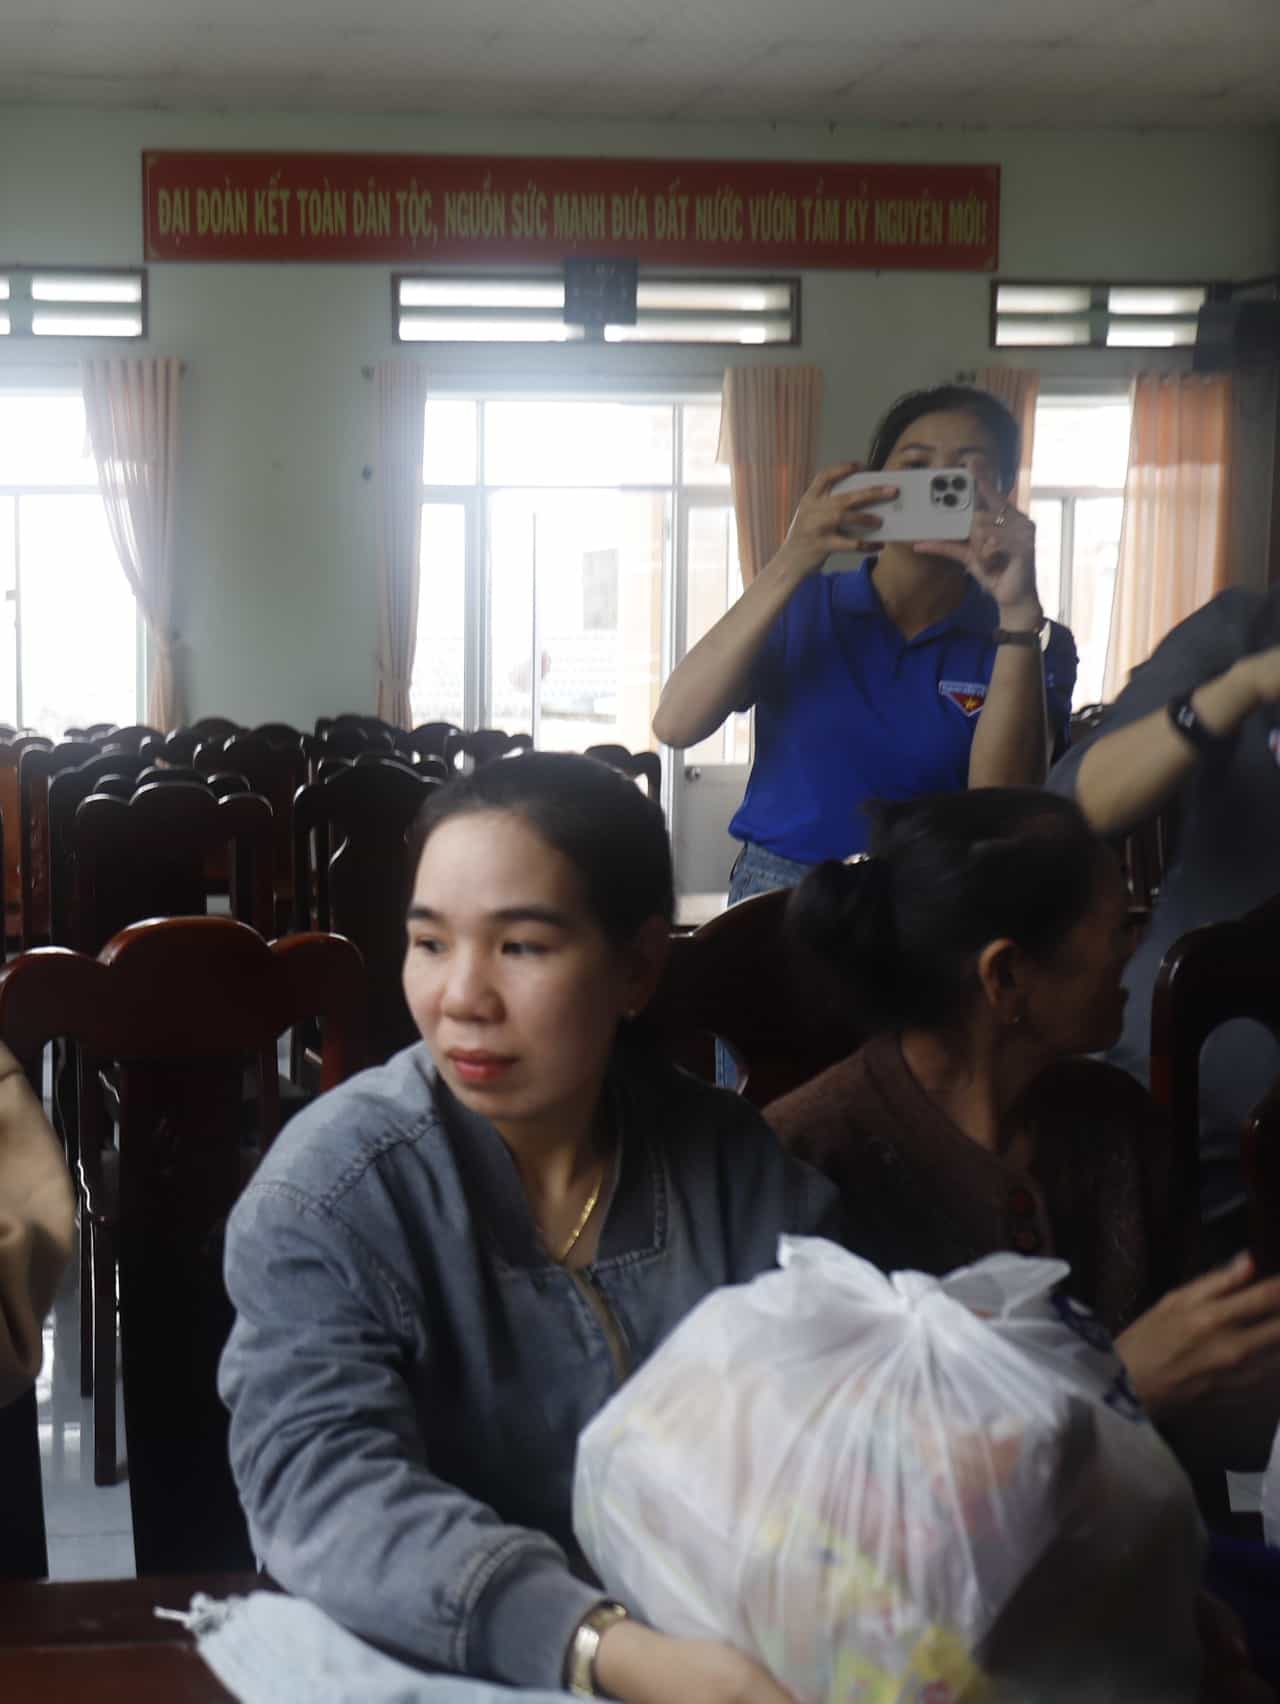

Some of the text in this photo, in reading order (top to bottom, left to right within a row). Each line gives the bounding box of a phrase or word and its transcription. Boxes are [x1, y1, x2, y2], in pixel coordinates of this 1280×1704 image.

[195, 175, 249, 238] ĐOÀN
[254, 169, 290, 238] KẾT
[297, 176, 347, 238] TOÀN
[352, 176, 392, 239] DÂN
